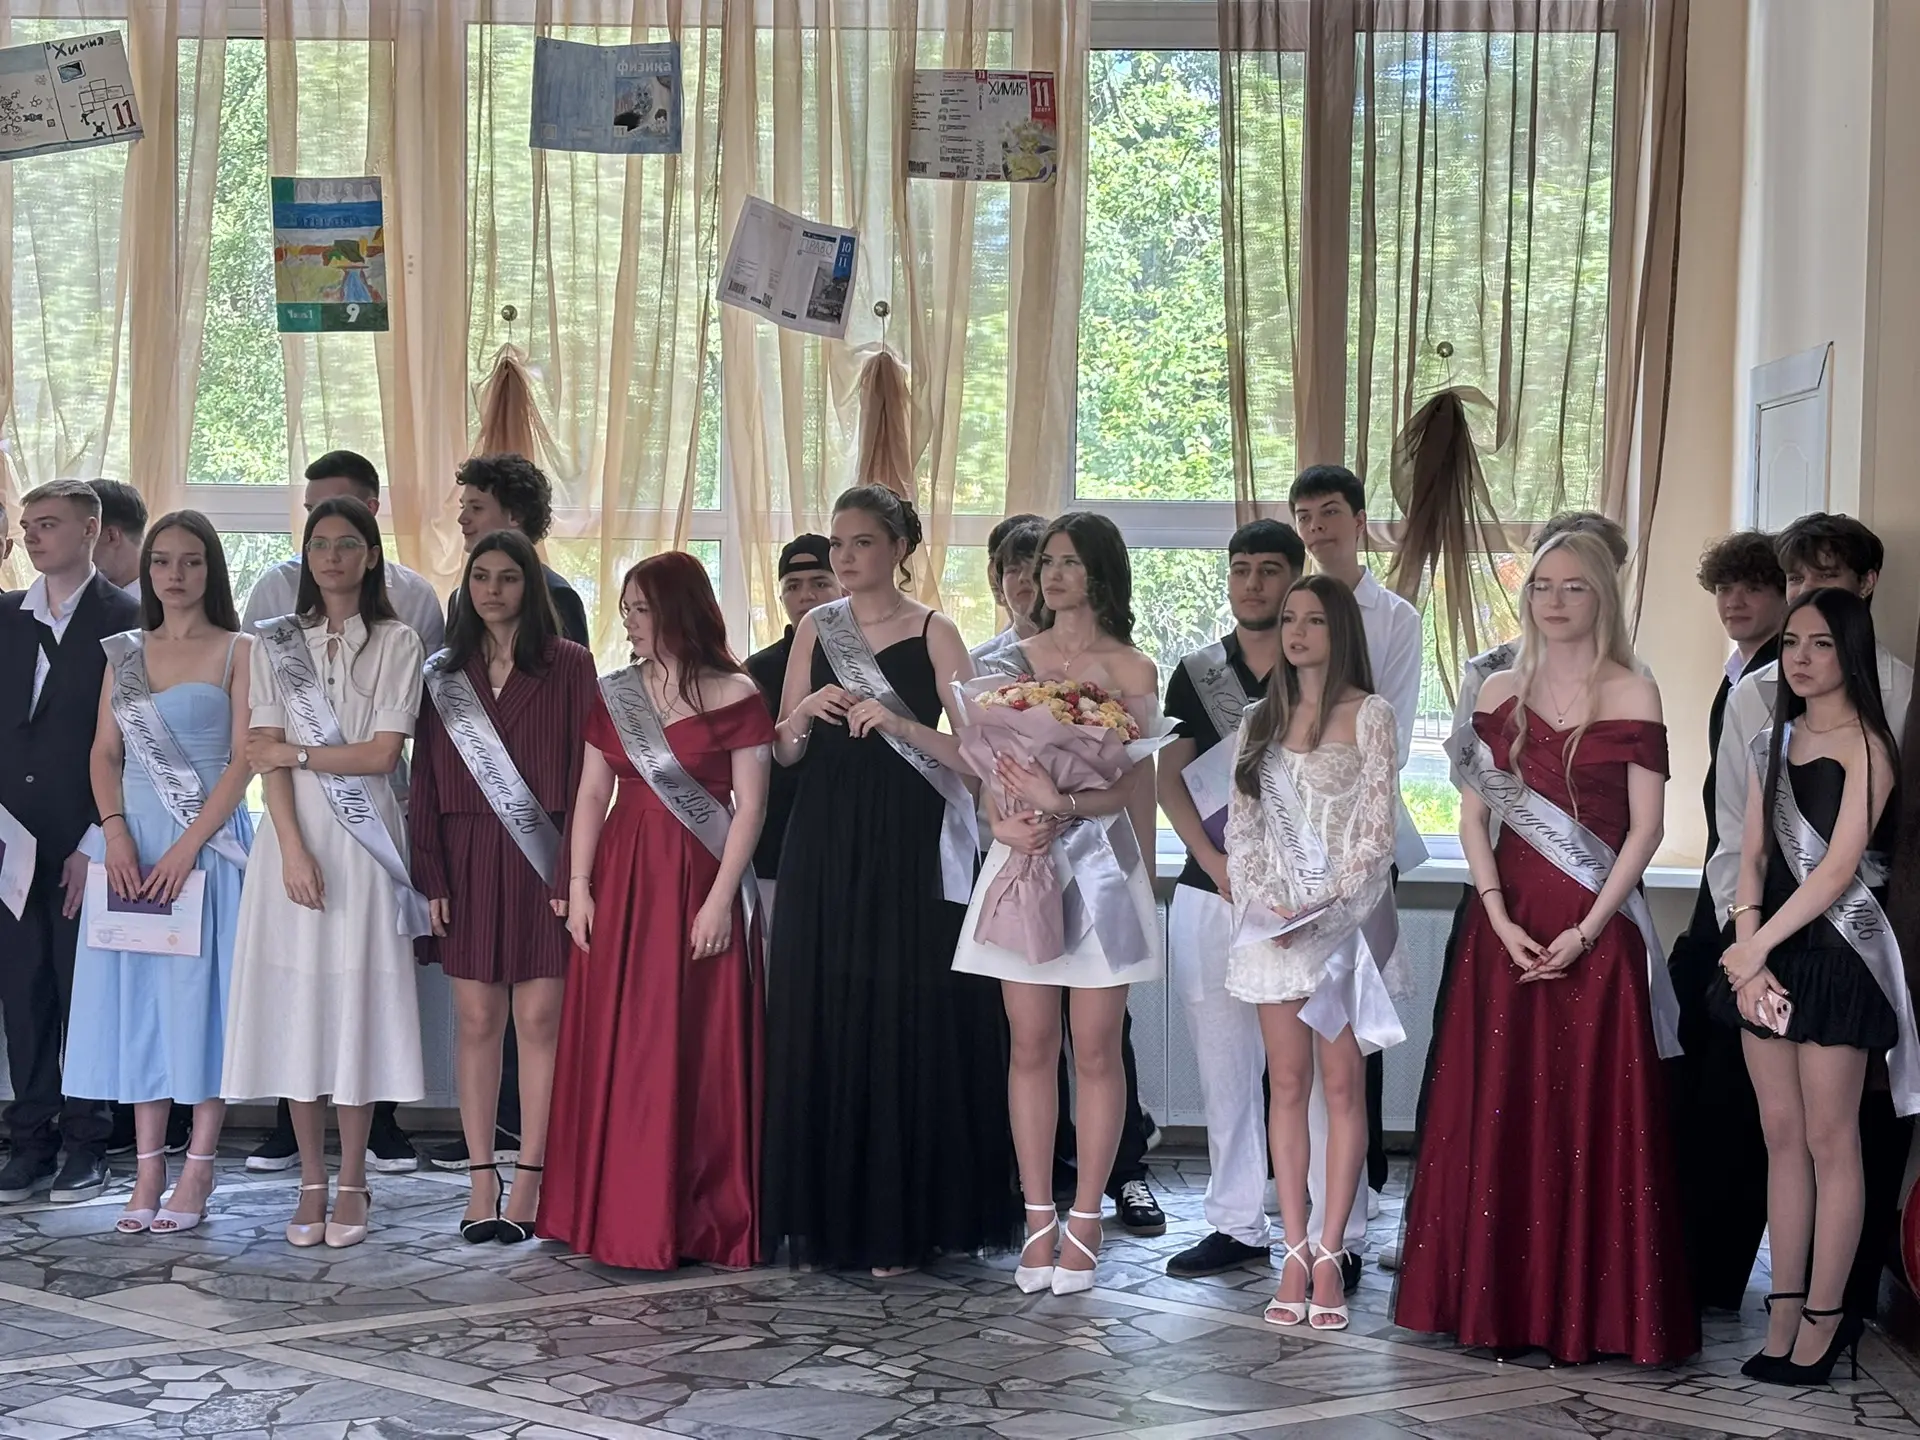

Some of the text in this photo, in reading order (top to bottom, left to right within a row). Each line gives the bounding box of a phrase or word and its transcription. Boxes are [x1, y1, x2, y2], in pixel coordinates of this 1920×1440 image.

[52, 36, 104, 60] Химия
[988, 81, 1028, 96] ХИМИЯ
[1032, 81, 1050, 107] 11
[112, 99, 137, 131] 11
[841, 241, 852, 253] 10
[838, 256, 848, 268] 11
[346, 303, 360, 323] 9
[438, 680, 545, 835] Выпускница 2026
[613, 687, 717, 824] Выпускница 2026
[334, 788, 375, 824] 2026
[1835, 899, 1885, 940] 2026
